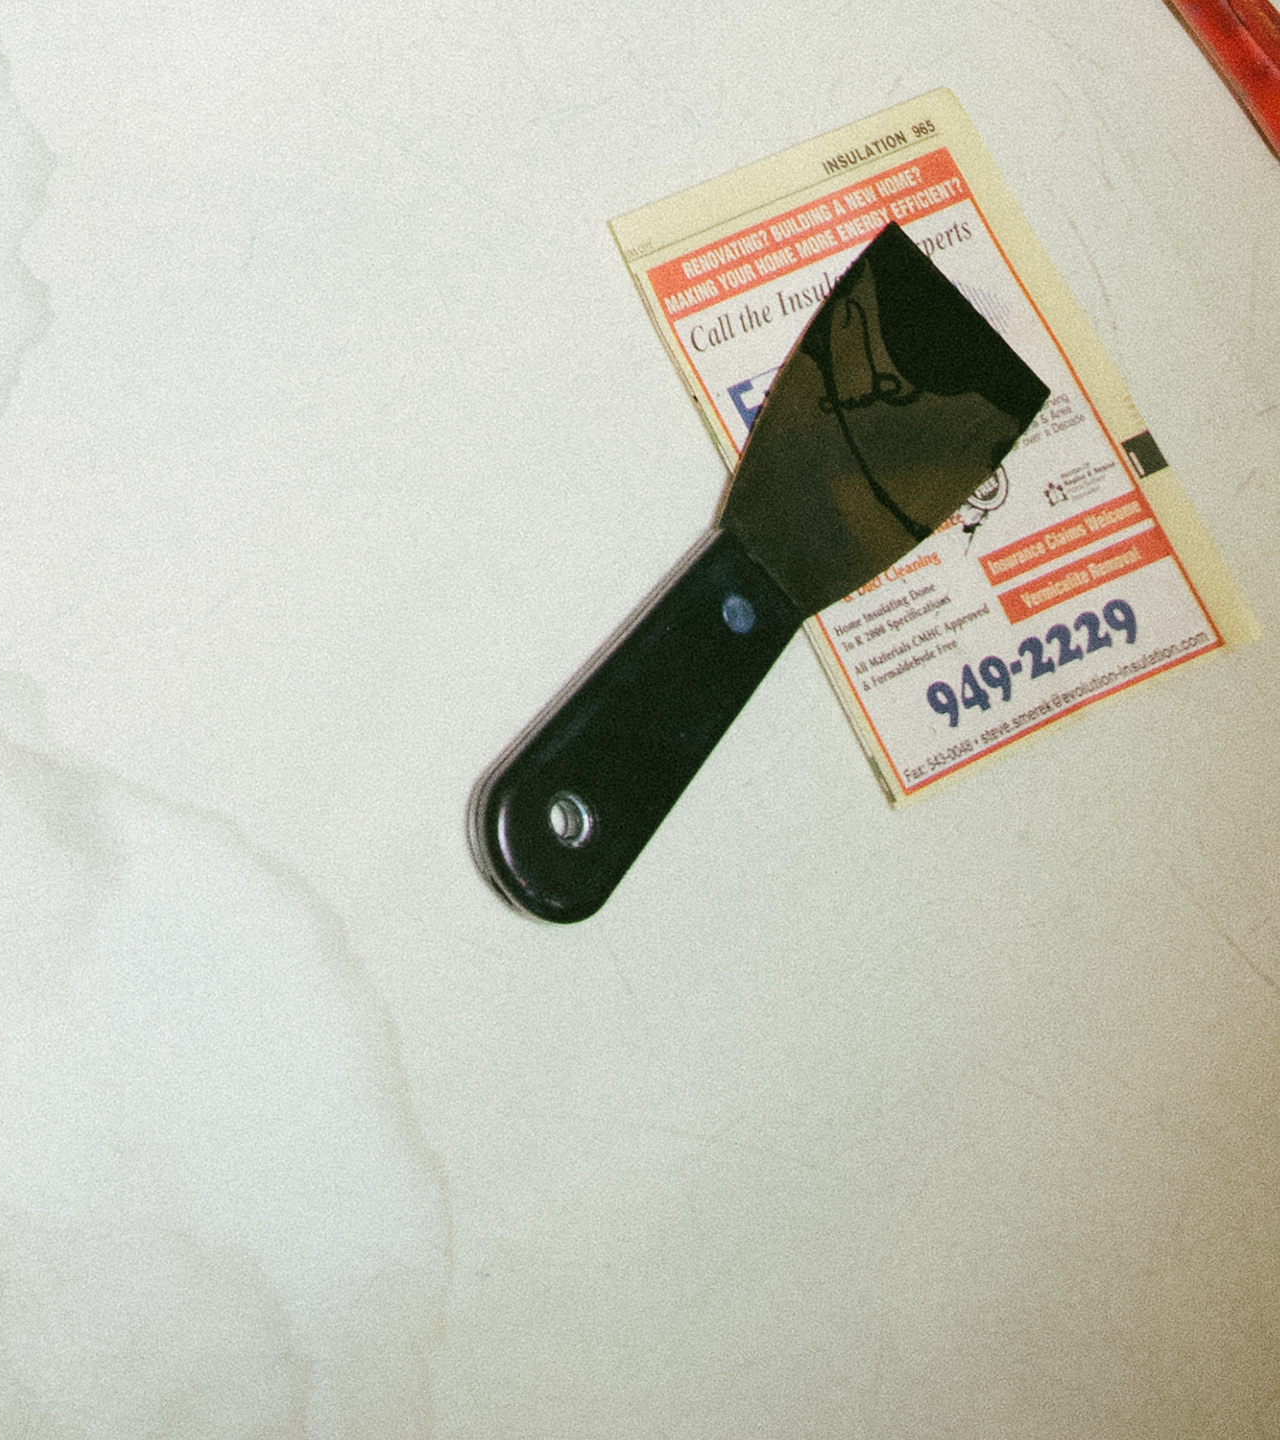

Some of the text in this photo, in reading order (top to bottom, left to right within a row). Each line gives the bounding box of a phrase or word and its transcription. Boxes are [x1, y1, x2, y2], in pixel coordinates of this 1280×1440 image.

[821, 118, 937, 175] INSULATION 965
[663, 175, 964, 314] MAKING YOUR HOME MORE ENERGY EFFICIENT?
[681, 228, 770, 280] RENOVATING?
[769, 203, 831, 242] BUILDING
[831, 197, 846, 217] A
[843, 185, 876, 211] NEW
[876, 165, 924, 198] HOME?
[687, 312, 737, 354] Call
[735, 296, 774, 333] the
[1052, 413, 1086, 434] Decade
[987, 496, 1142, 576] Insurance Claims Welcome
[1088, 544, 1142, 579] Removal
[884, 550, 942, 584] Cleaning
[833, 581, 936, 637] Home Insulating Done
[886, 593, 952, 632] Specifications
[853, 602, 991, 675] All Materials CMHC Approved
[870, 648, 936, 687] Formaldehyde
[935, 636, 958, 655] Free
[926, 598, 1137, 728] 949-2229
